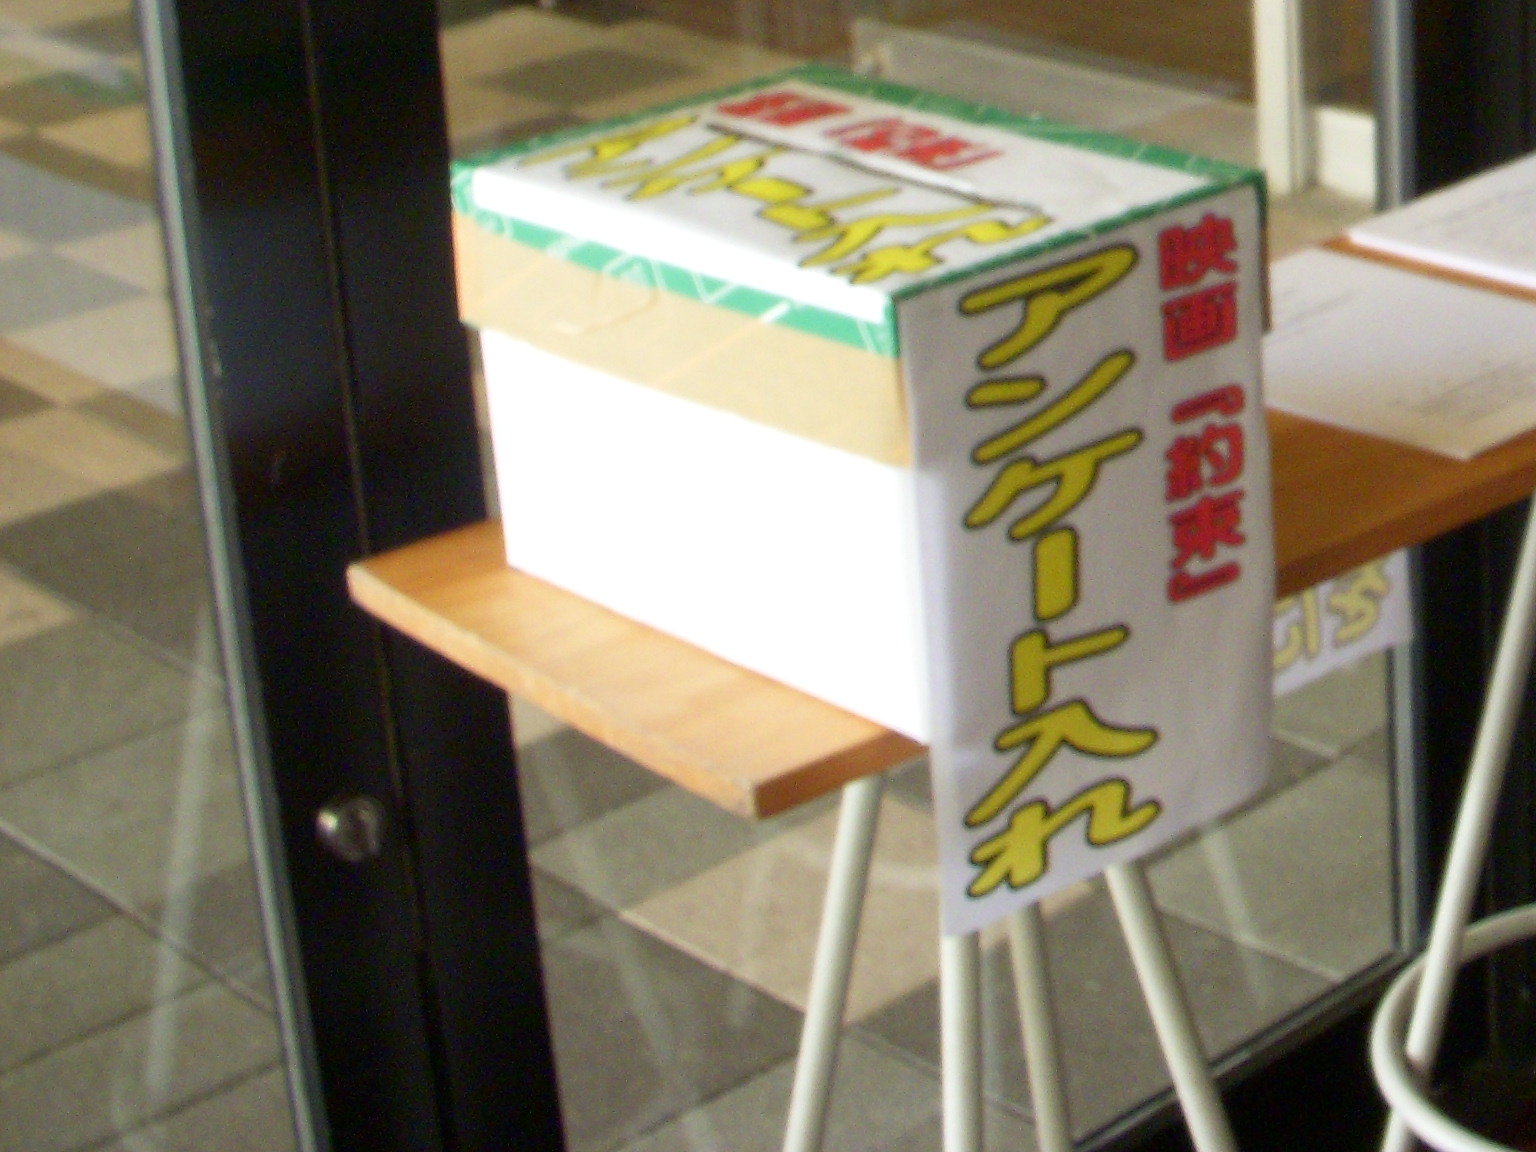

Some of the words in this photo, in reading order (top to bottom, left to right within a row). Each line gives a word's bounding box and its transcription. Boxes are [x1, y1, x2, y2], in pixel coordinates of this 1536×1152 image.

[959, 244, 1163, 897] アンケート入れ
